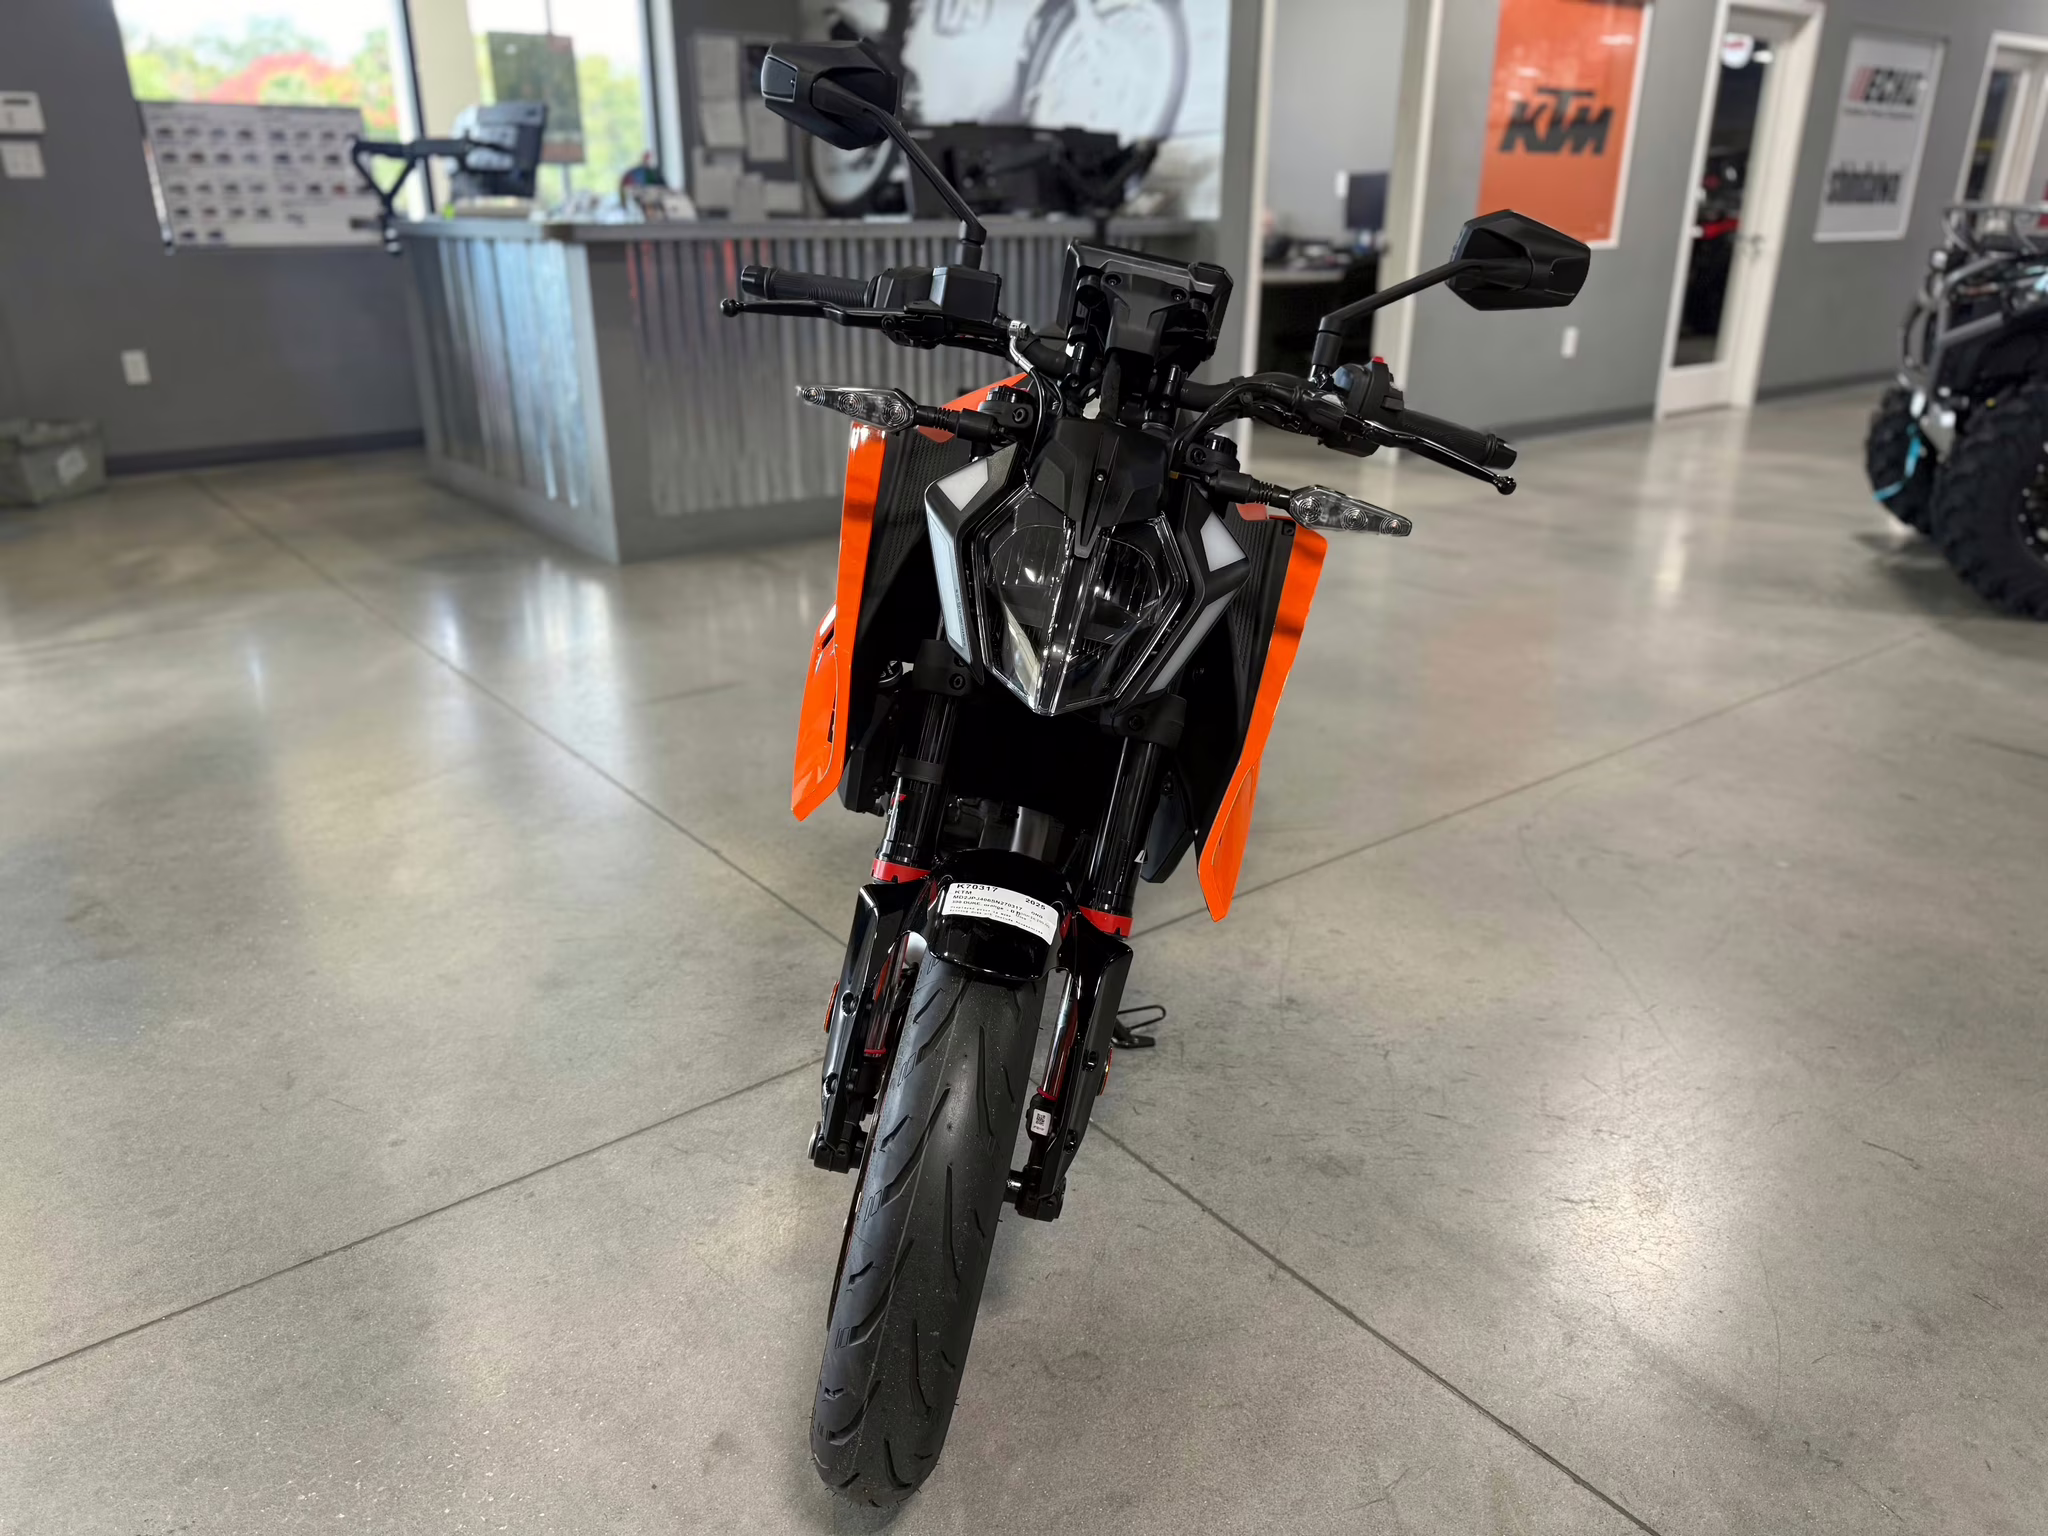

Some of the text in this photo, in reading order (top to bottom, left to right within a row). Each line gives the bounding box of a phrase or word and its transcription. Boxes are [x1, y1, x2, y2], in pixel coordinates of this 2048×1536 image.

[1499, 86, 1615, 156] KTM
[956, 883, 998, 892] K70317
[1025, 897, 1046, 910] 2025
